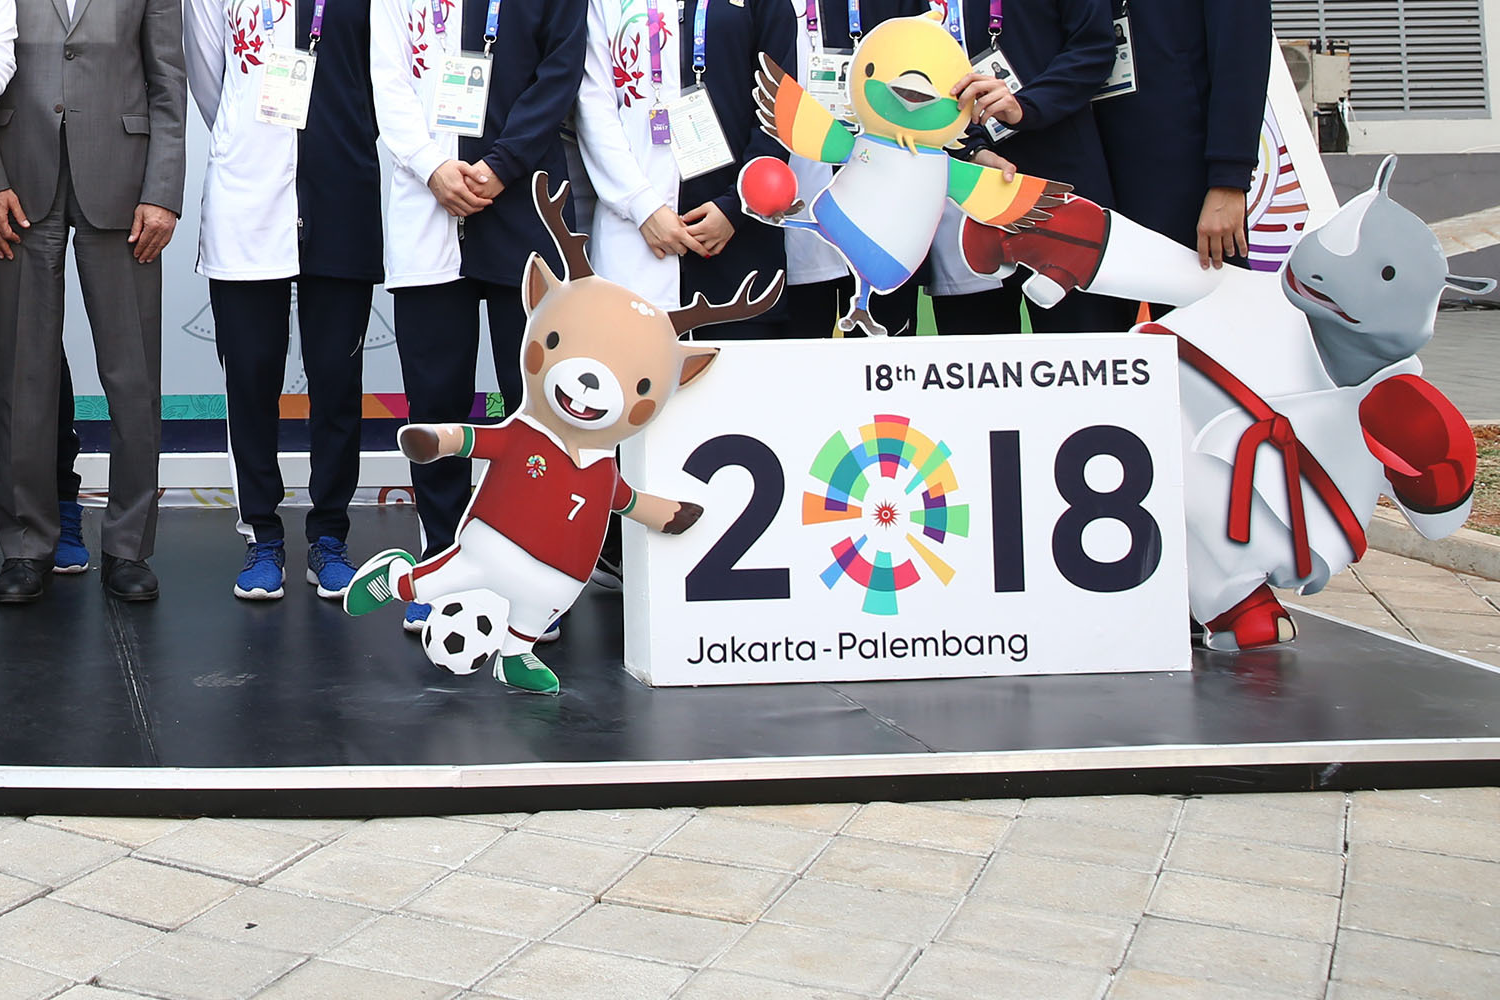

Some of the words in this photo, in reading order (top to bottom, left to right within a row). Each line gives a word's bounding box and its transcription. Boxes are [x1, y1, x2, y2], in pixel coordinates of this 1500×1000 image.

[865, 363, 916, 392] 18th
[922, 360, 1023, 391] ASIAN
[1030, 358, 1151, 388] GAMES
[567, 493, 586, 521] 7
